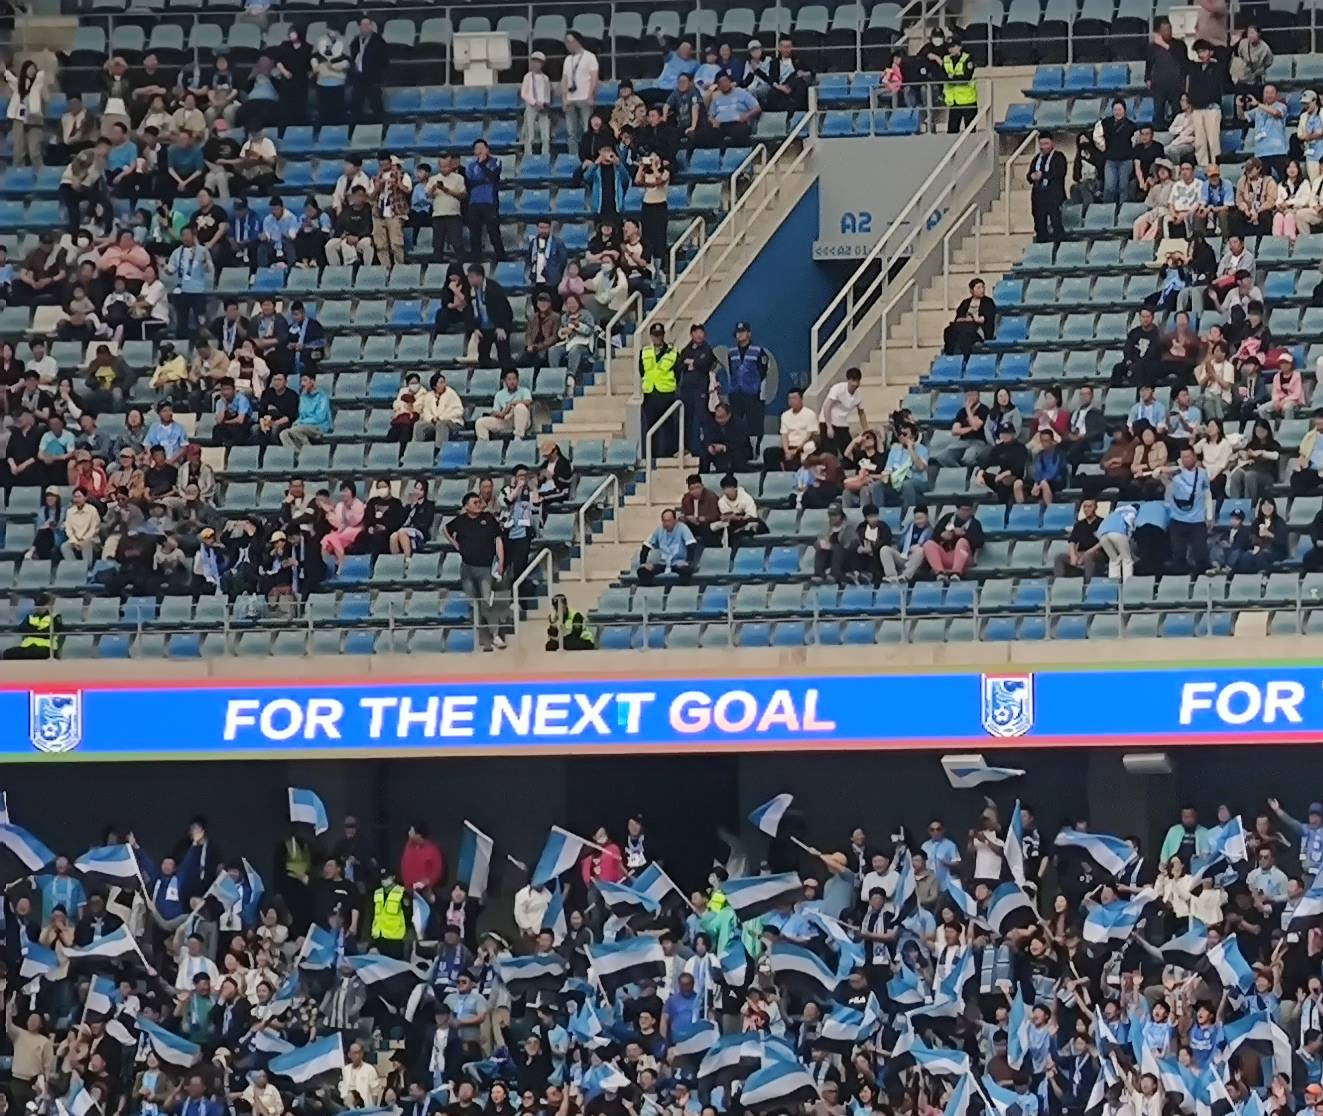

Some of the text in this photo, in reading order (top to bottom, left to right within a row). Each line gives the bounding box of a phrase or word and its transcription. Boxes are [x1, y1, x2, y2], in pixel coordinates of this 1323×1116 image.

[840, 212, 872, 234] A2
[224, 689, 836, 741] FOR THE NEXT GOAL
[1180, 682, 1305, 725] FOR
